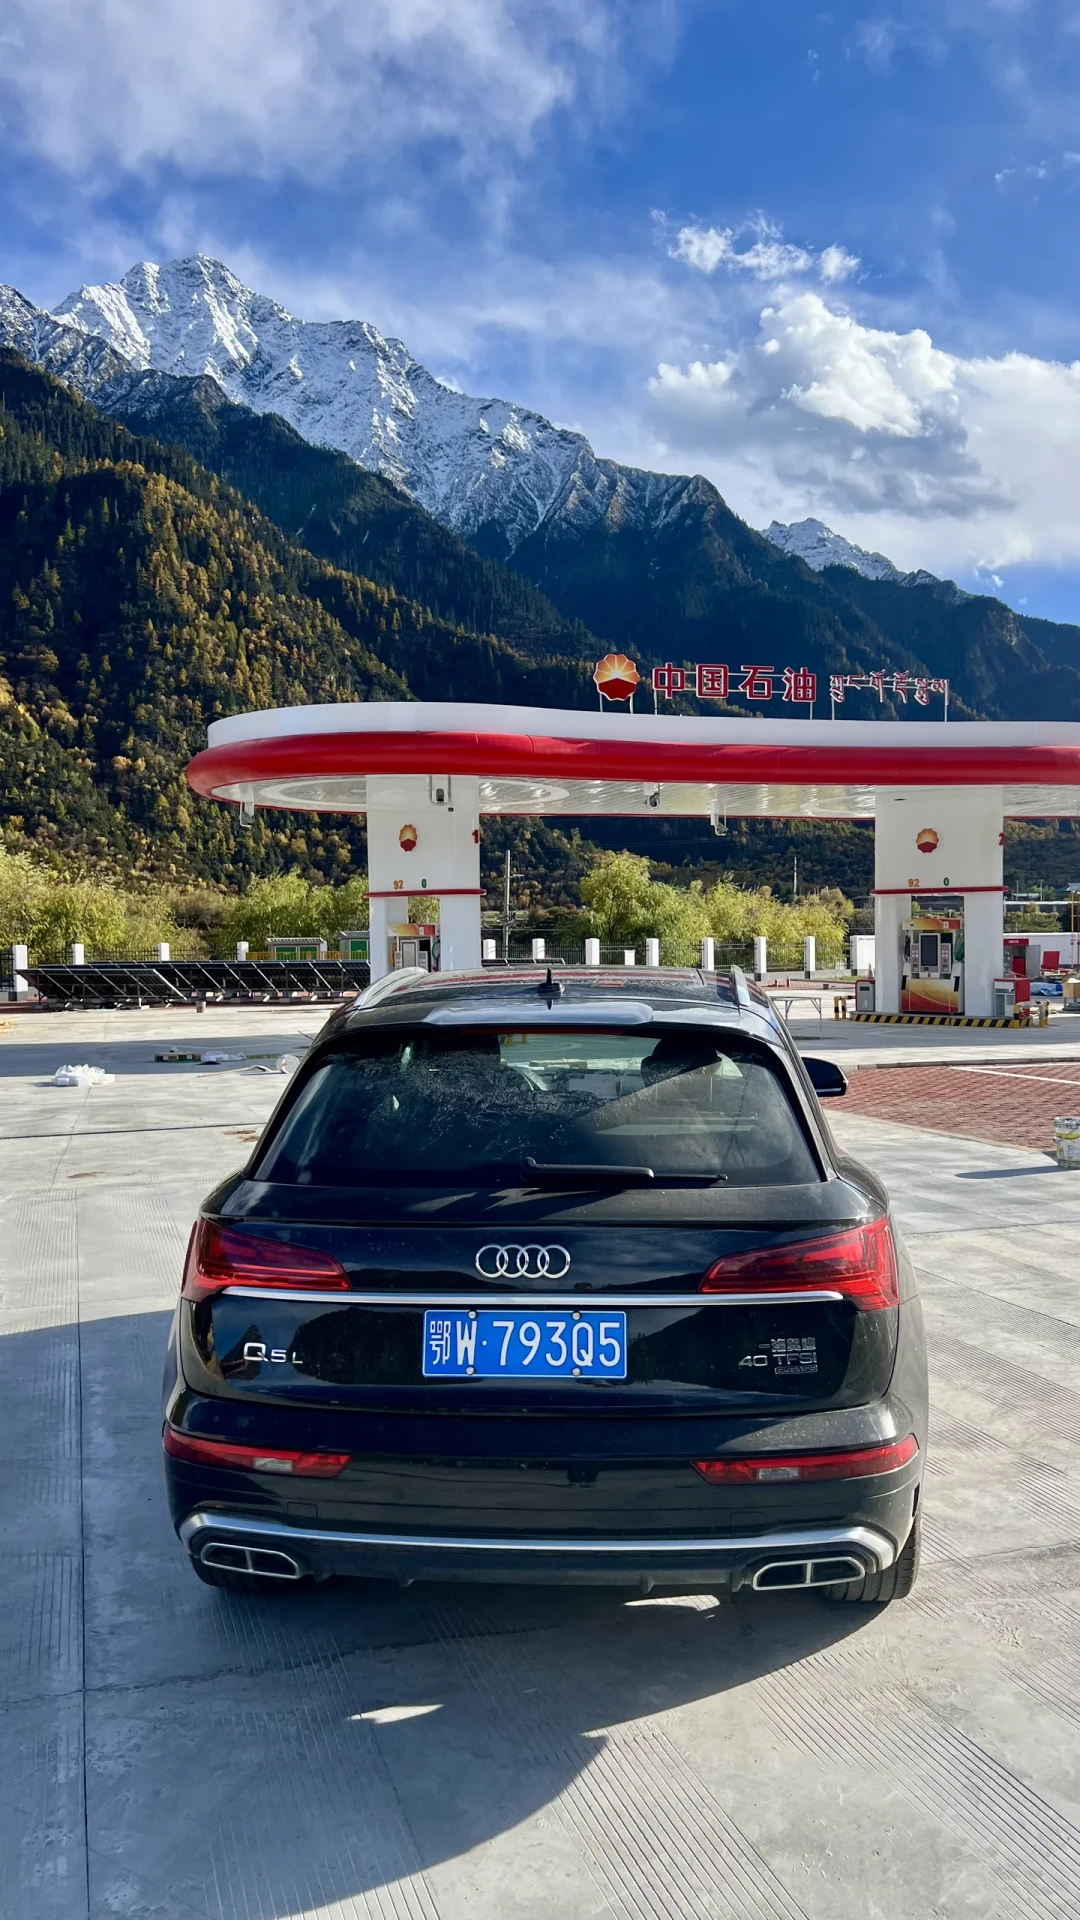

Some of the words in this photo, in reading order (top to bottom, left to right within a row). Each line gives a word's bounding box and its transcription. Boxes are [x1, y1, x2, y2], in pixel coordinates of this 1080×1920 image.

[652, 662, 816, 702] 中国石油
[393, 879, 404, 890] 92
[421, 878, 427, 889] 0
[908, 878, 920, 888] 92
[943, 877, 950, 887] 0
[738, 1355, 768, 1367] 40
[772, 1352, 817, 1365] TFSI
